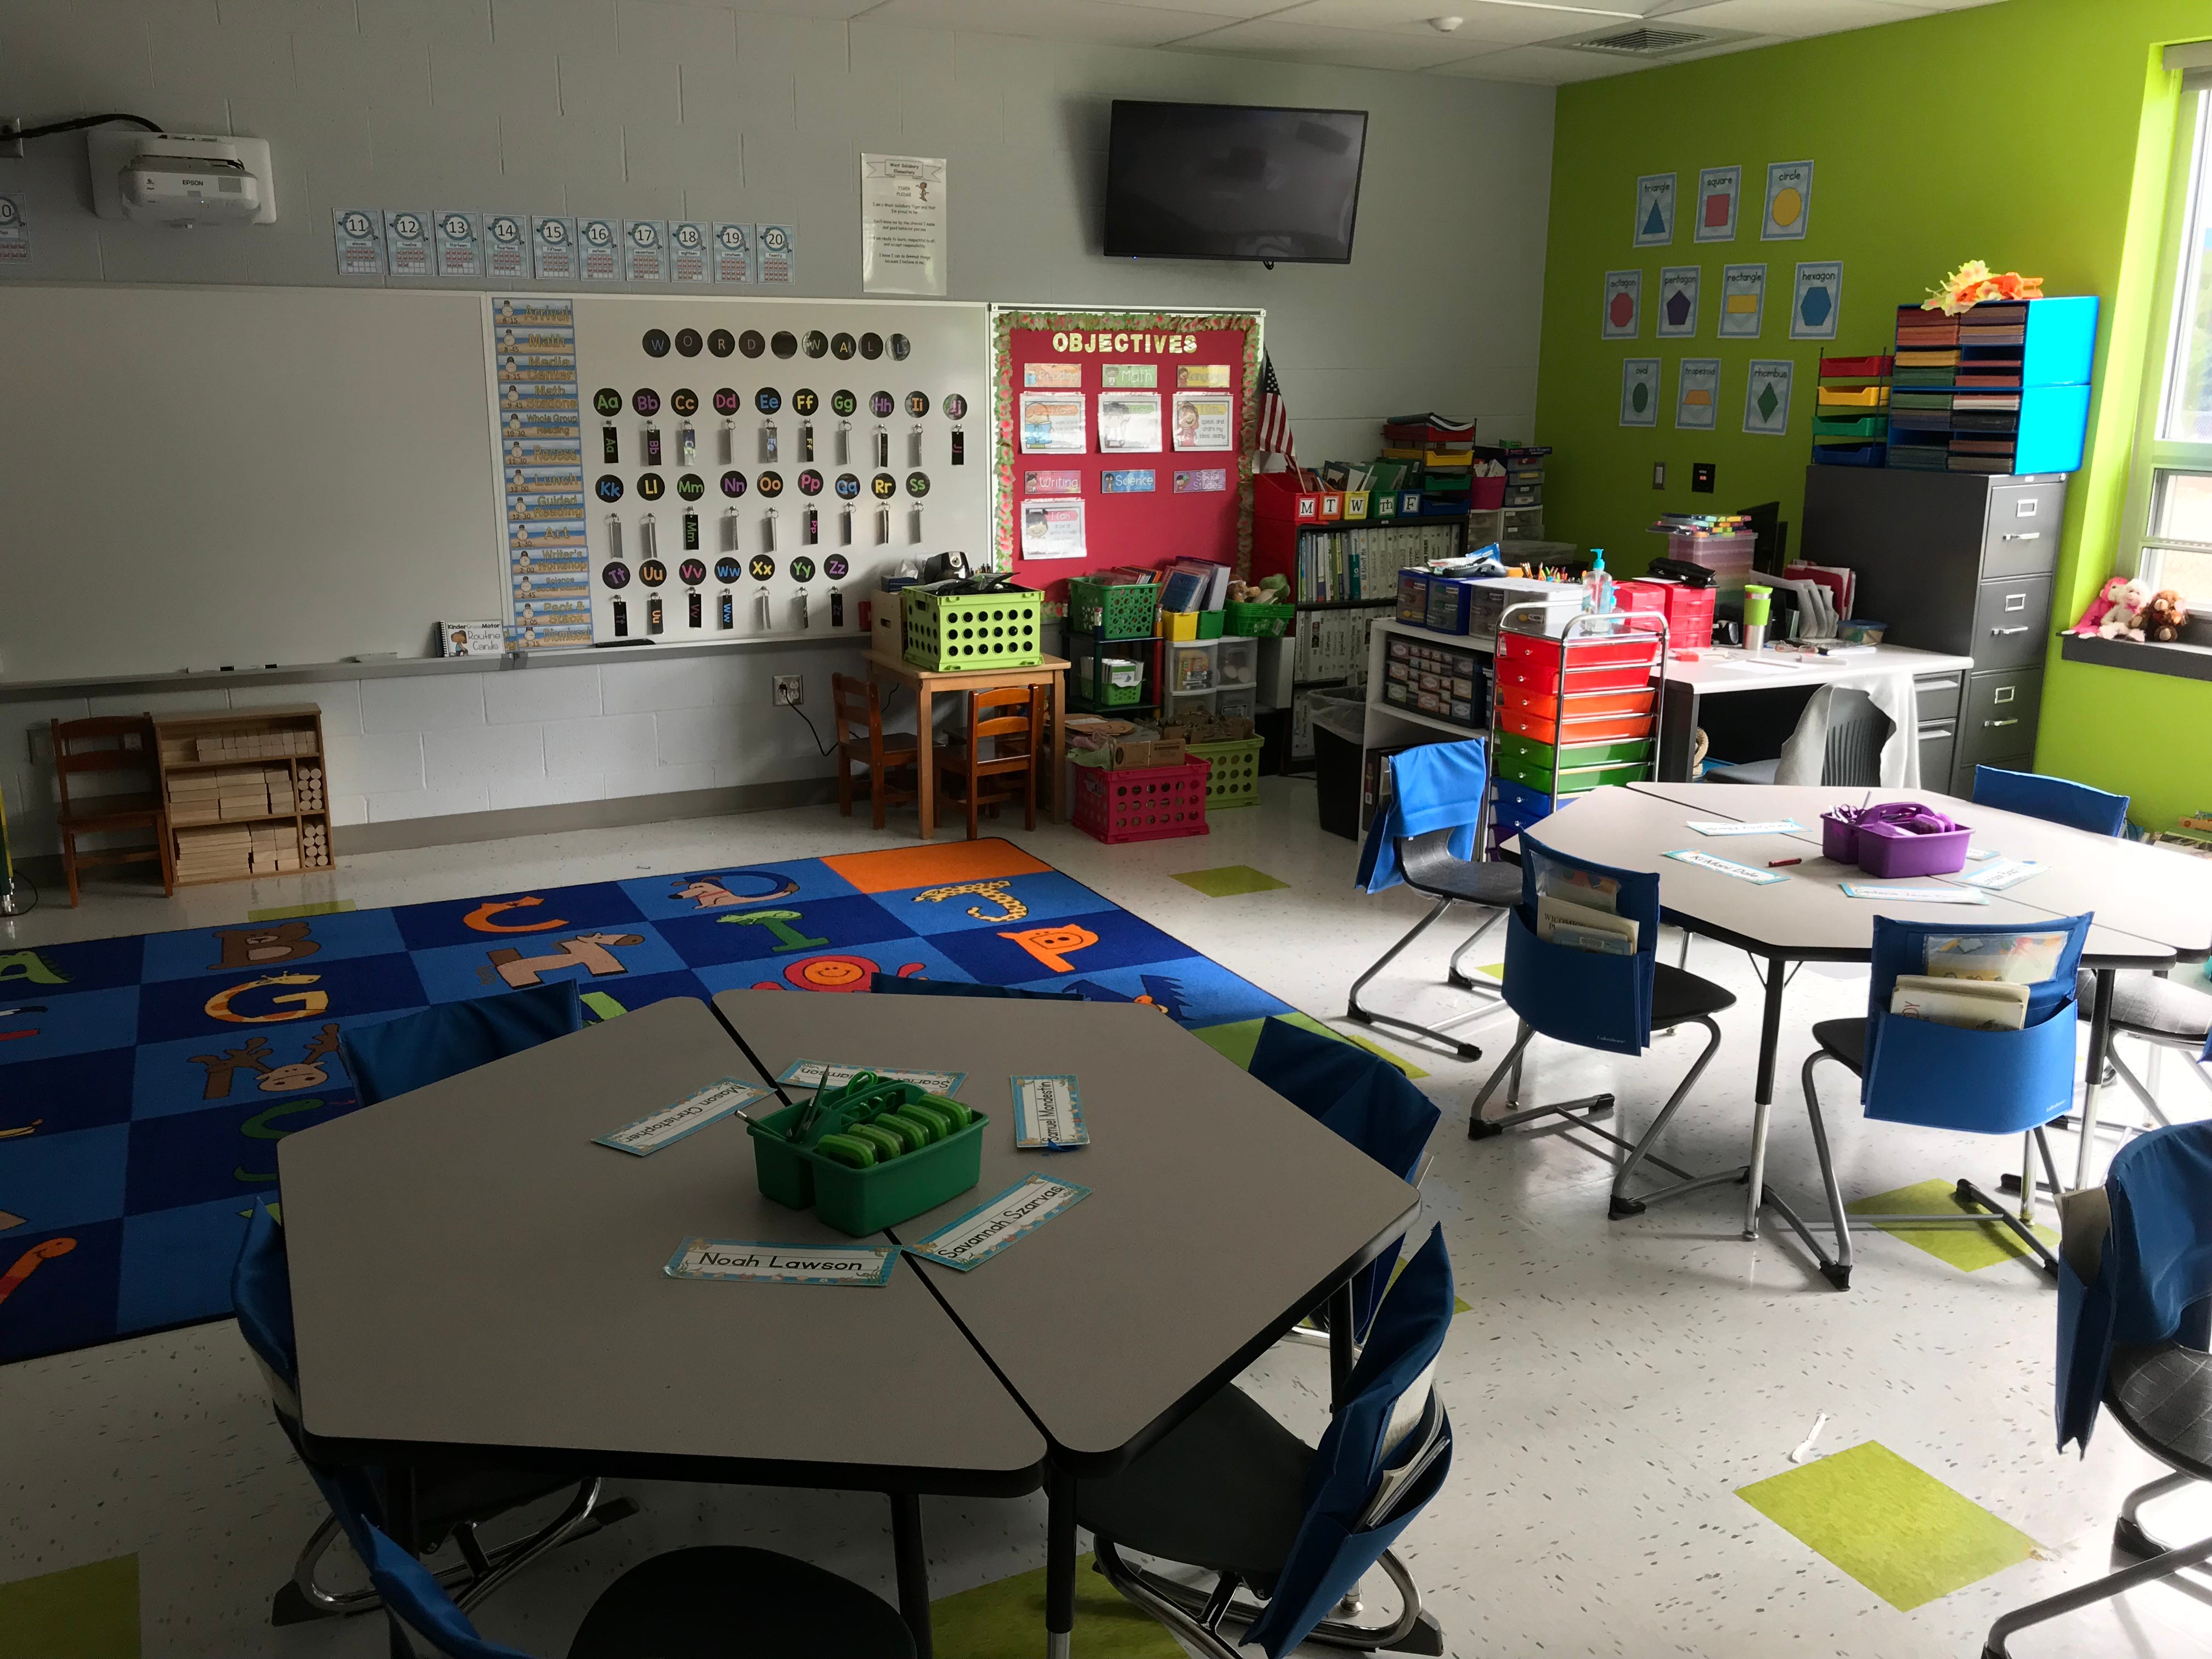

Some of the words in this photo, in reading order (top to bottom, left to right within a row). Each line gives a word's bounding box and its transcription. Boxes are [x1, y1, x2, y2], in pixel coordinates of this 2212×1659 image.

[1707, 176, 1733, 188] square
[1779, 172, 1801, 182] circle
[1644, 183, 1670, 193] triangle
[349, 219, 366, 232] 11
[399, 221, 416, 234] 12
[449, 221, 466, 234] 13
[498, 224, 514, 236] 14
[545, 226, 561, 238] 15
[591, 228, 607, 240] 16
[637, 230, 652, 242] 17
[681, 231, 697, 243] 18
[725, 232, 740, 244] 19
[768, 233, 783, 245] 20
[1664, 275, 1696, 286] pentagon
[1727, 271, 1762, 284] rectangle
[1802, 270, 1836, 282] hexagon
[1610, 280, 1636, 289] octagon
[524, 306, 569, 321] Arrival
[528, 334, 566, 348] Math
[1052, 332, 1198, 354] OBJECTIVES
[528, 356, 570, 367] Media
[527, 370, 573, 380] Center
[1120, 369, 1153, 383] Math
[1635, 366, 1648, 375] oval
[1754, 369, 1787, 378] rhombus
[1037, 371, 1079, 385] Reading
[534, 386, 566, 396] Math
[527, 398, 577, 408] Stations
[597, 394, 619, 409] Aa
[636, 395, 658, 411] Bb
[675, 395, 695, 410] Cc
[715, 393, 736, 409] Dd
[759, 394, 780, 409] Ee
[796, 395, 814, 410] Ff
[833, 396, 854, 413] Gg
[873, 397, 892, 413] Hh
[527, 414, 551, 422] Whole
[552, 415, 577, 424] Group
[605, 438, 615, 454] Aa
[648, 441, 658, 455] Bb
[533, 445, 577, 461] Recess
[534, 474, 578, 486] Lunch
[801, 473, 821, 493] Pp
[1039, 476, 1079, 489] Writing
[1115, 475, 1153, 487] Science
[1195, 471, 1220, 482] Social
[600, 481, 622, 498] Kk
[678, 480, 704, 494] Mm
[724, 477, 746, 493] Nn
[759, 476, 781, 492] Oo
[836, 479, 859, 495] Qq
[874, 479, 893, 494] Rr
[909, 478, 926, 492] Ss
[1192, 481, 1223, 490] Studies
[537, 495, 578, 506] Guided
[1327, 499, 1336, 512] T
[1351, 499, 1363, 512] W
[1380, 500, 1393, 512] Th
[1406, 497, 1417, 510] F
[533, 506, 583, 518] Reading
[1300, 501, 1313, 514] M
[544, 527, 570, 539] Art
[686, 522, 698, 543] Mm
[542, 549, 583, 558] Writer's
[536, 560, 587, 572] Workshop
[681, 564, 703, 579] Vv
[716, 565, 741, 578] Ww
[752, 560, 773, 576] Xx
[793, 561, 812, 579] Yy
[829, 560, 845, 575] Zz
[608, 567, 627, 584] Tt
[643, 566, 663, 581] Uu
[543, 602, 572, 612] Pack
[576, 601, 585, 611] &
[723, 603, 732, 623] Ww
[549, 613, 584, 623] Stack
[652, 609, 661, 623] Uu
[467, 630, 501, 640] Routine
[543, 627, 591, 642] Dismissal
[472, 640, 499, 650] Cards
[702, 1085, 747, 1105] Mason
[1036, 1081, 1056, 1117] Mondestin
[625, 1106, 703, 1143] Christopher
[1039, 1118, 1059, 1142] Samuel
[938, 1220, 1012, 1258] Savannah
[1003, 1186, 1064, 1220] Szarvas
[698, 1252, 760, 1267] Noah
[769, 1255, 862, 1271] Lawson
